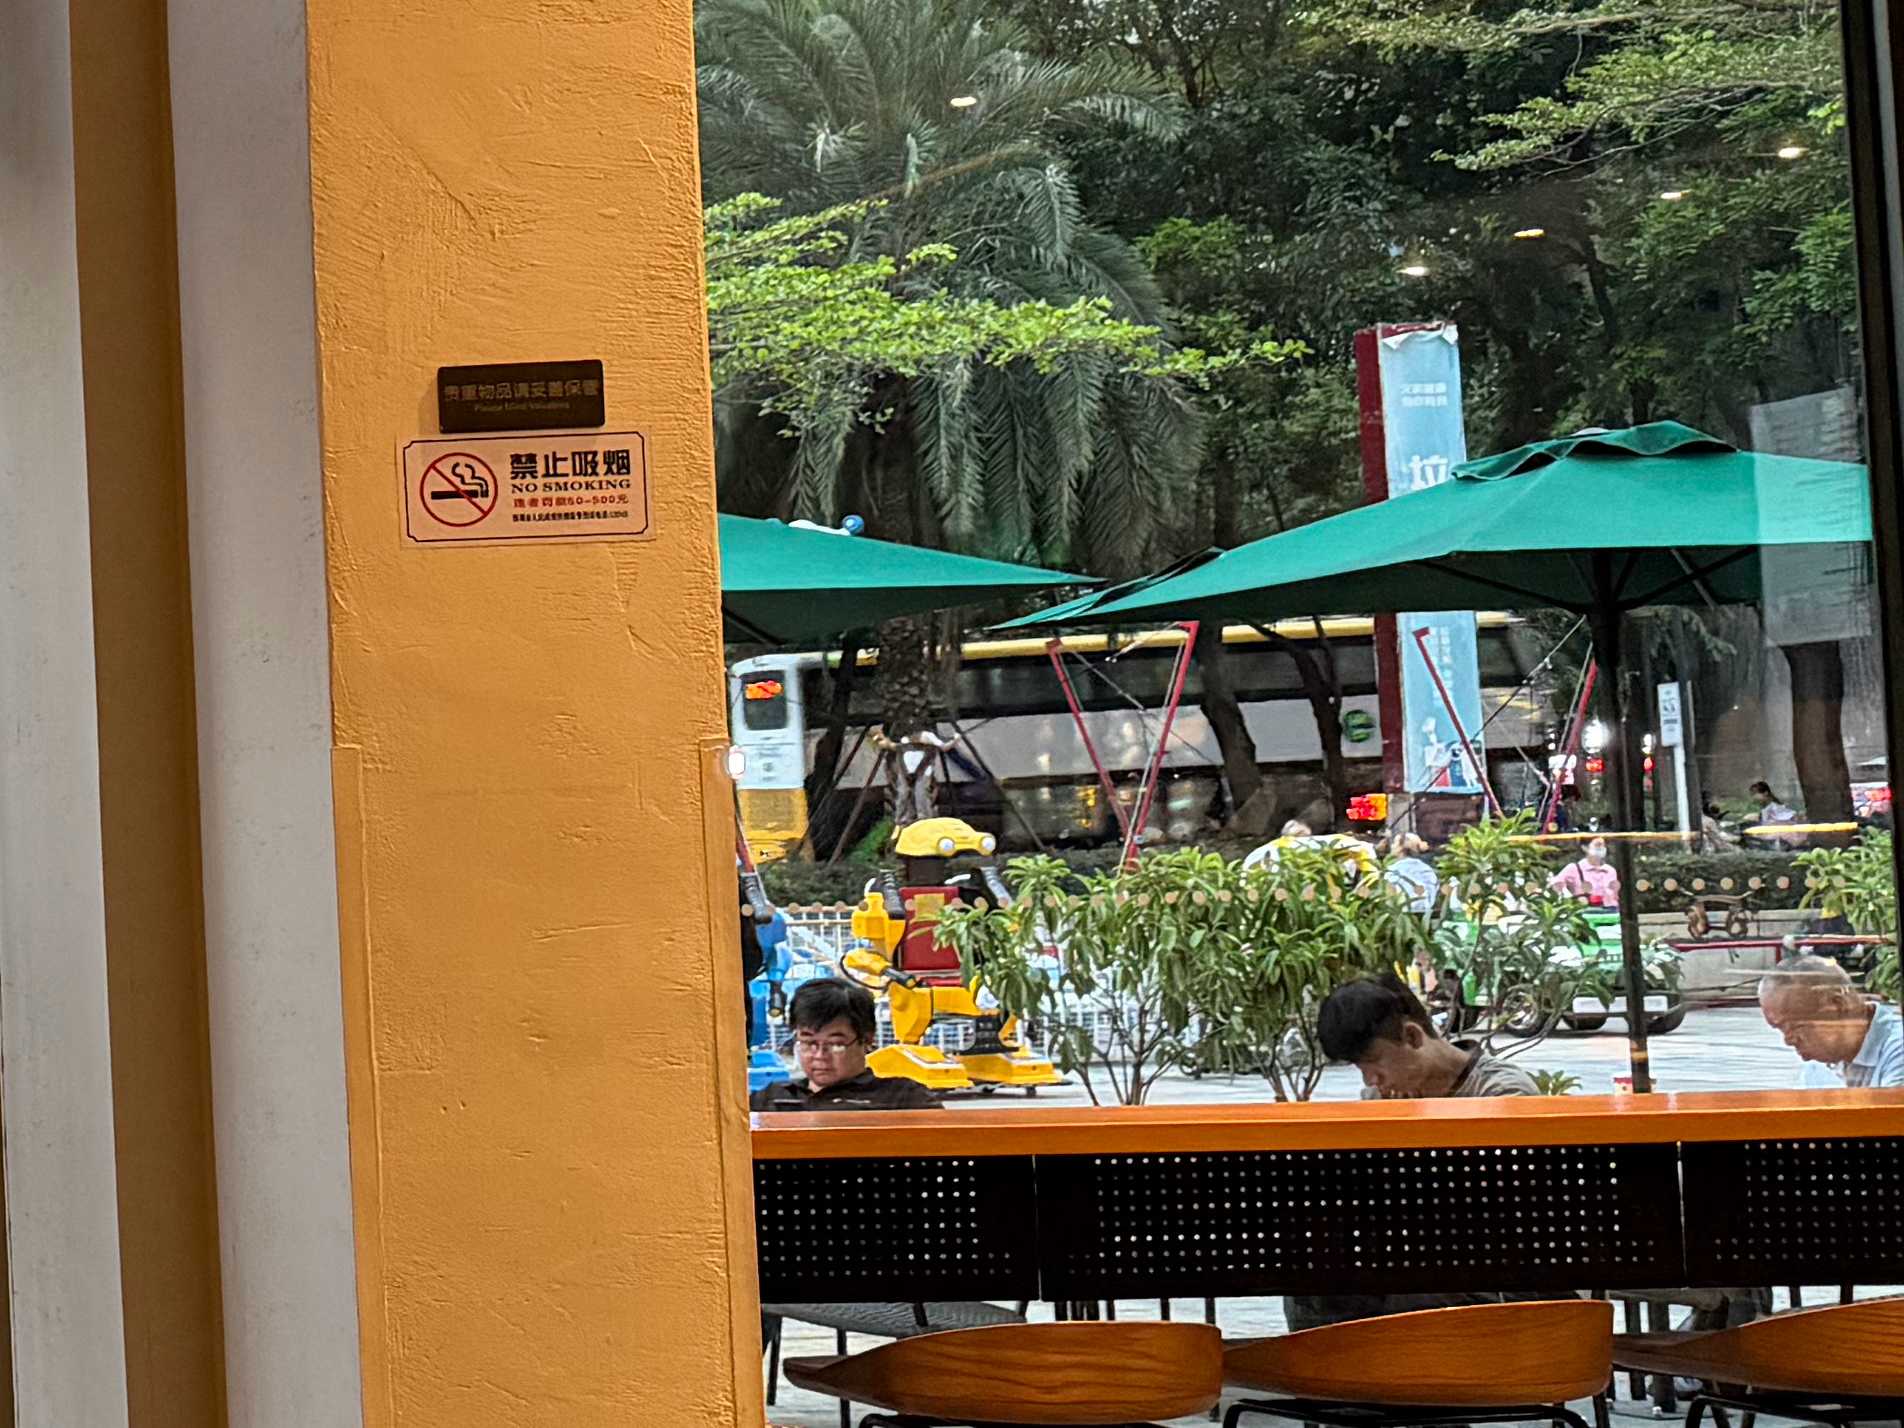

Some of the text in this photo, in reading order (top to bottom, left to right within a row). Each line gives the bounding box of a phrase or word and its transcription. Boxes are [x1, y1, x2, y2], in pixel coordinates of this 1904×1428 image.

[510, 449, 631, 479] 禁止吸烟
[511, 479, 631, 494] NO SMOKING
